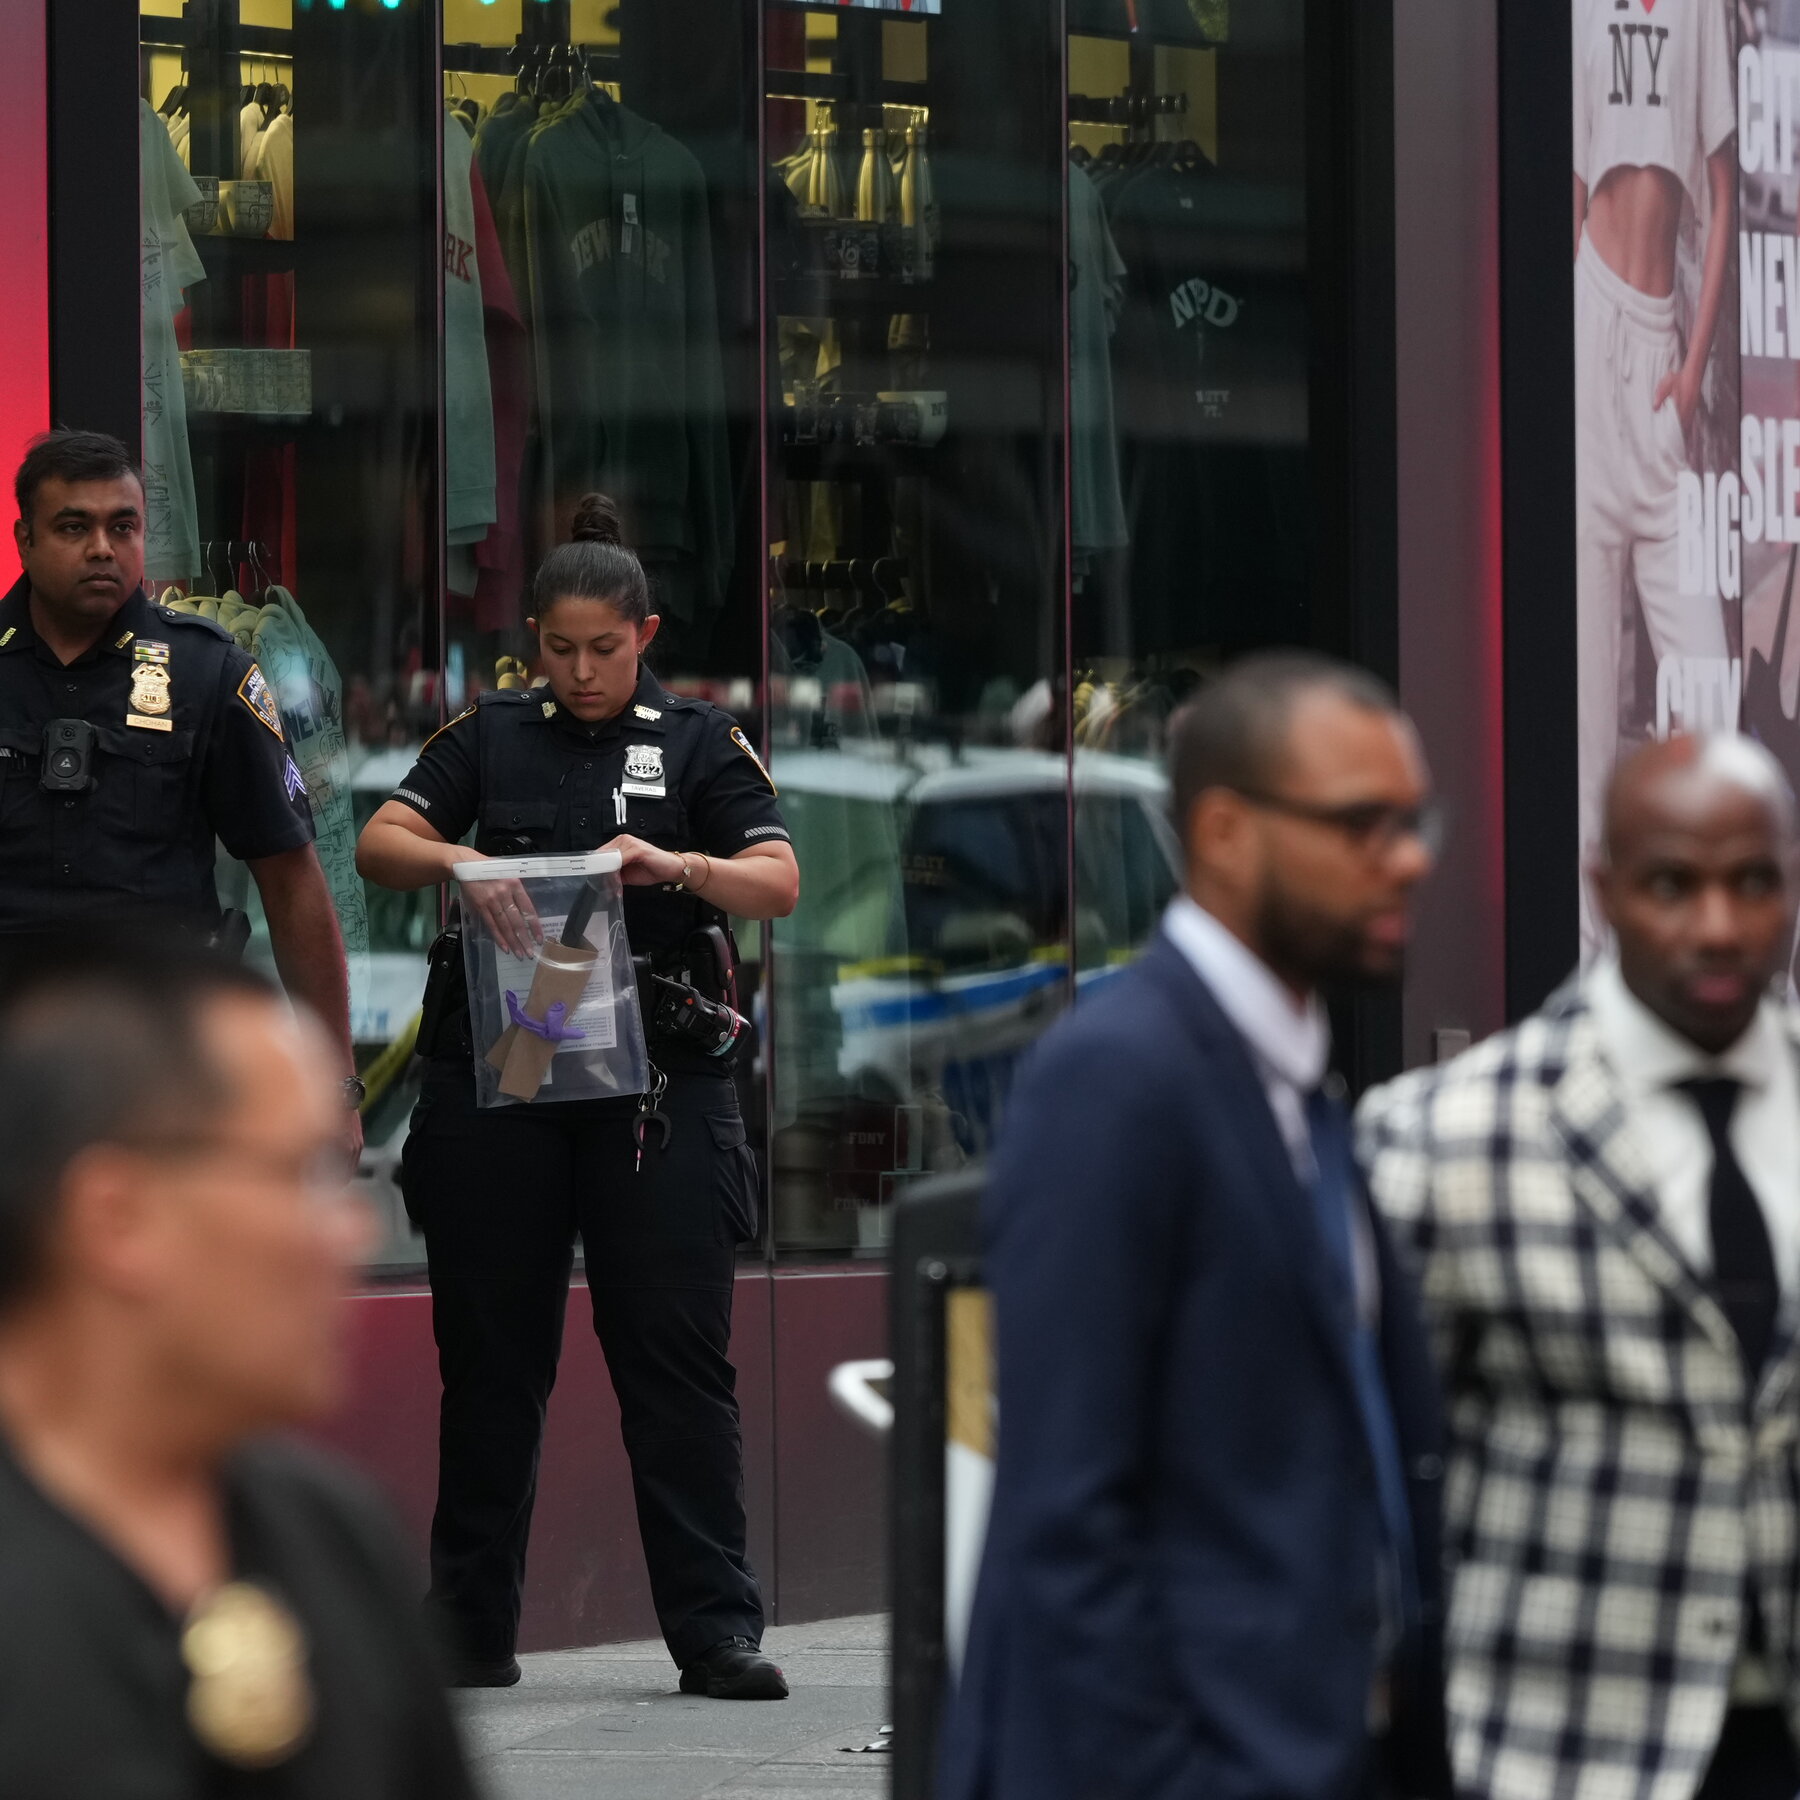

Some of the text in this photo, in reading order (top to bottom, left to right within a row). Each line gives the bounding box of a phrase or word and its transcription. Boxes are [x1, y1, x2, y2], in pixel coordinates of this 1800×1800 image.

[1608, 23, 1669, 106] NY
[1677, 469, 1741, 600] BIG
[1656, 654, 1741, 742] CITY
[848, 1131, 886, 1145] FDNY
